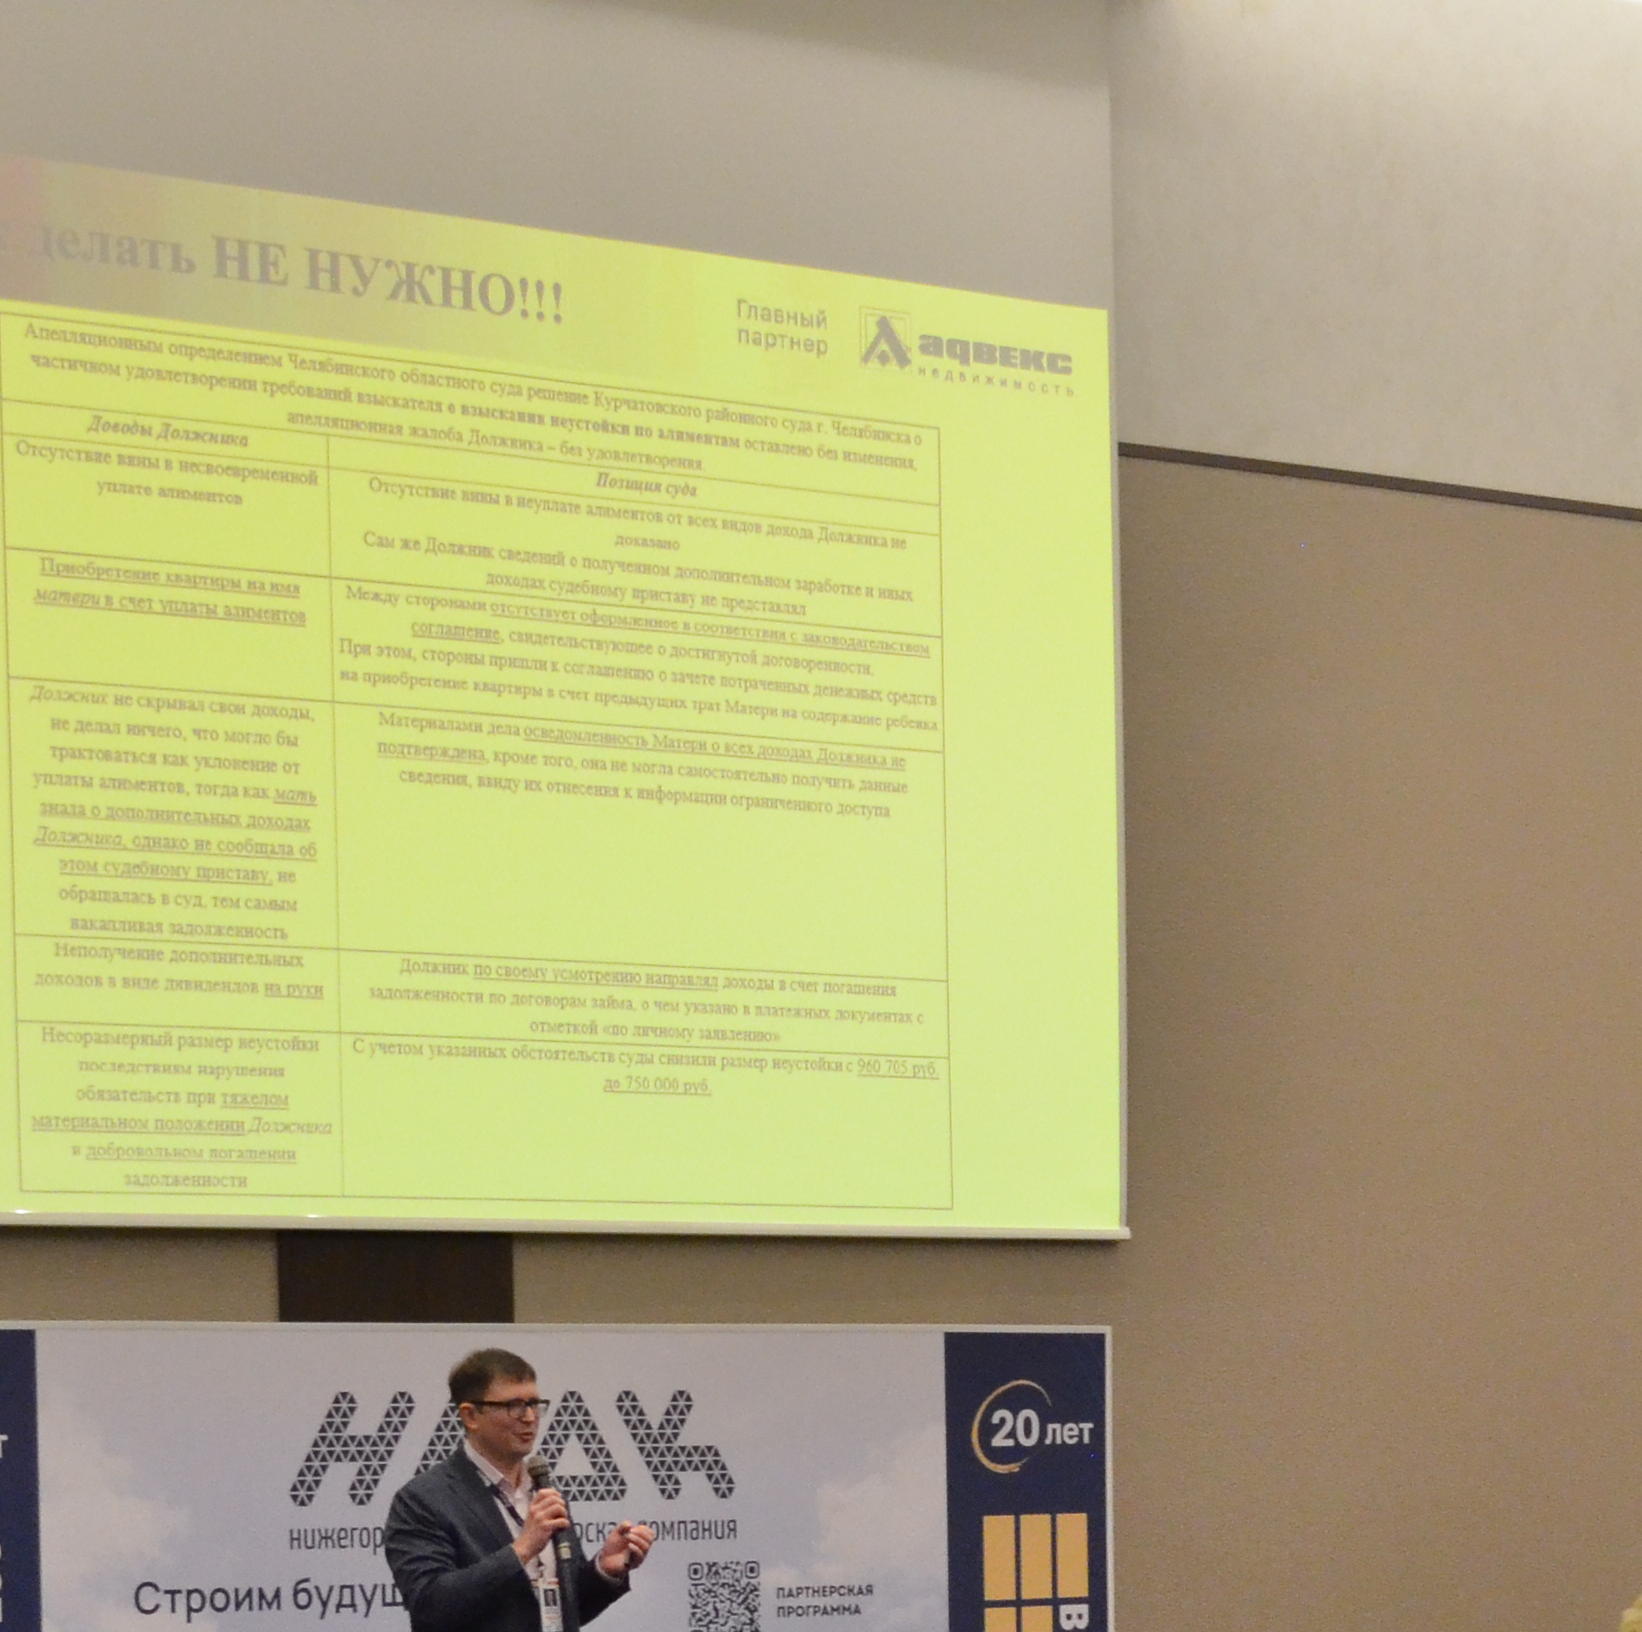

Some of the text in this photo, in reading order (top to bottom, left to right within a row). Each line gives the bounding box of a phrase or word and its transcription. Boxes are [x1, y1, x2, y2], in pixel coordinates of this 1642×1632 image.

[212, 234, 290, 287] НЕ
[304, 247, 565, 325] НУЖНО!!!
[736, 298, 829, 331] Главный
[737, 327, 829, 357] партнер
[23, 317, 164, 353] Апелляционным
[166, 339, 283, 367] определением
[287, 350, 397, 381] Челябинского
[398, 364, 486, 392] областного
[488, 379, 524, 399] суда
[525, 383, 590, 404] решение
[592, 387, 702, 418] Курчатовского
[703, 403, 779, 427] районного
[779, 415, 814, 434] суда
[830, 416, 912, 443] Челябинска
[917, 366, 1077, 397] недвижимость
[86, 411, 249, 448] Доводы Должника
[285, 409, 404, 436] апелляционная
[407, 423, 464, 443] жалоба
[468, 426, 544, 452] Должника
[557, 436, 583, 456] без
[12, 435, 113, 464] Отсутствие
[115, 451, 161, 470] вины
[177, 458, 319, 486] несвоевременной
[95, 478, 244, 507] уплате алиментов
[594, 469, 698, 500] Позиция суда
[613, 532, 681, 552] доказано
[38, 553, 301, 596] Приобретение квартиры на имя
[31, 587, 101, 610] матери
[117, 595, 154, 611] счет
[158, 598, 218, 617] уплаты
[221, 604, 307, 625] алиментов
[484, 572, 807, 616] доходах судебному приставу не представлял
[343, 582, 401, 609] Между
[403, 592, 487, 613] сторонами
[488, 601, 576, 624] отсутствует
[579, 605, 679, 631] оформленное
[692, 620, 787, 641] соответствии
[801, 630, 931, 655] законодательством
[507, 630, 654, 658] свидетельствующее
[668, 645, 758, 667] достигнутой
[28, 680, 109, 705] Должник
[111, 692, 134, 707] не
[135, 694, 206, 714] скрывал
[207, 700, 247, 716] свои
[47, 744, 301, 775] трактоваться как уклонение от
[475, 775, 521, 795] ввиду
[522, 778, 543, 793] их
[545, 780, 620, 798] отнесения
[635, 783, 728, 808] информации
[728, 793, 833, 813] ограниченного
[836, 801, 891, 820] доступа
[37, 801, 87, 817] знала
[103, 805, 242, 827] дополнительных
[245, 814, 312, 835] доходах
[130, 834, 189, 853] однако
[192, 838, 212, 852] не
[215, 836, 295, 860] сообщала
[297, 840, 319, 859] об
[57, 858, 99, 874] этом
[102, 858, 190, 883] судебному
[276, 871, 297, 885] не
[54, 882, 157, 907] обращалась
[210, 895, 241, 910] тем
[242, 897, 299, 913] самым
[167, 921, 289, 941] задолженность
[50, 938, 305, 968] Неполучение дополнительных
[39, 1023, 320, 1054] Несоразмерный размер неустойки
[528, 1018, 599, 1035] отметкой
[601, 1018, 628, 1036] «по
[631, 1024, 694, 1043] личному
[76, 1058, 286, 1081] последствиям нарушения
[602, 1077, 621, 1094] до
[626, 1073, 650, 1091] 750
[652, 1074, 680, 1092] 000
[74, 1082, 290, 1109] обязательств при тяжелом
[29, 1114, 334, 1136] материальном положении Должника
[84, 1139, 204, 1162] добровольном
[208, 1146, 297, 1162] погашении
[122, 1172, 248, 1191] задолженности
[990, 1408, 1095, 1448] 20 лет
[289, 1526, 386, 1556] нижегор
[640, 1518, 738, 1542] омпания
[133, 1576, 409, 1624] Строим будущ
[776, 1584, 874, 1599] ПАРТНЕРСКАЯ
[776, 1603, 863, 1618] ПРОГРАММА
